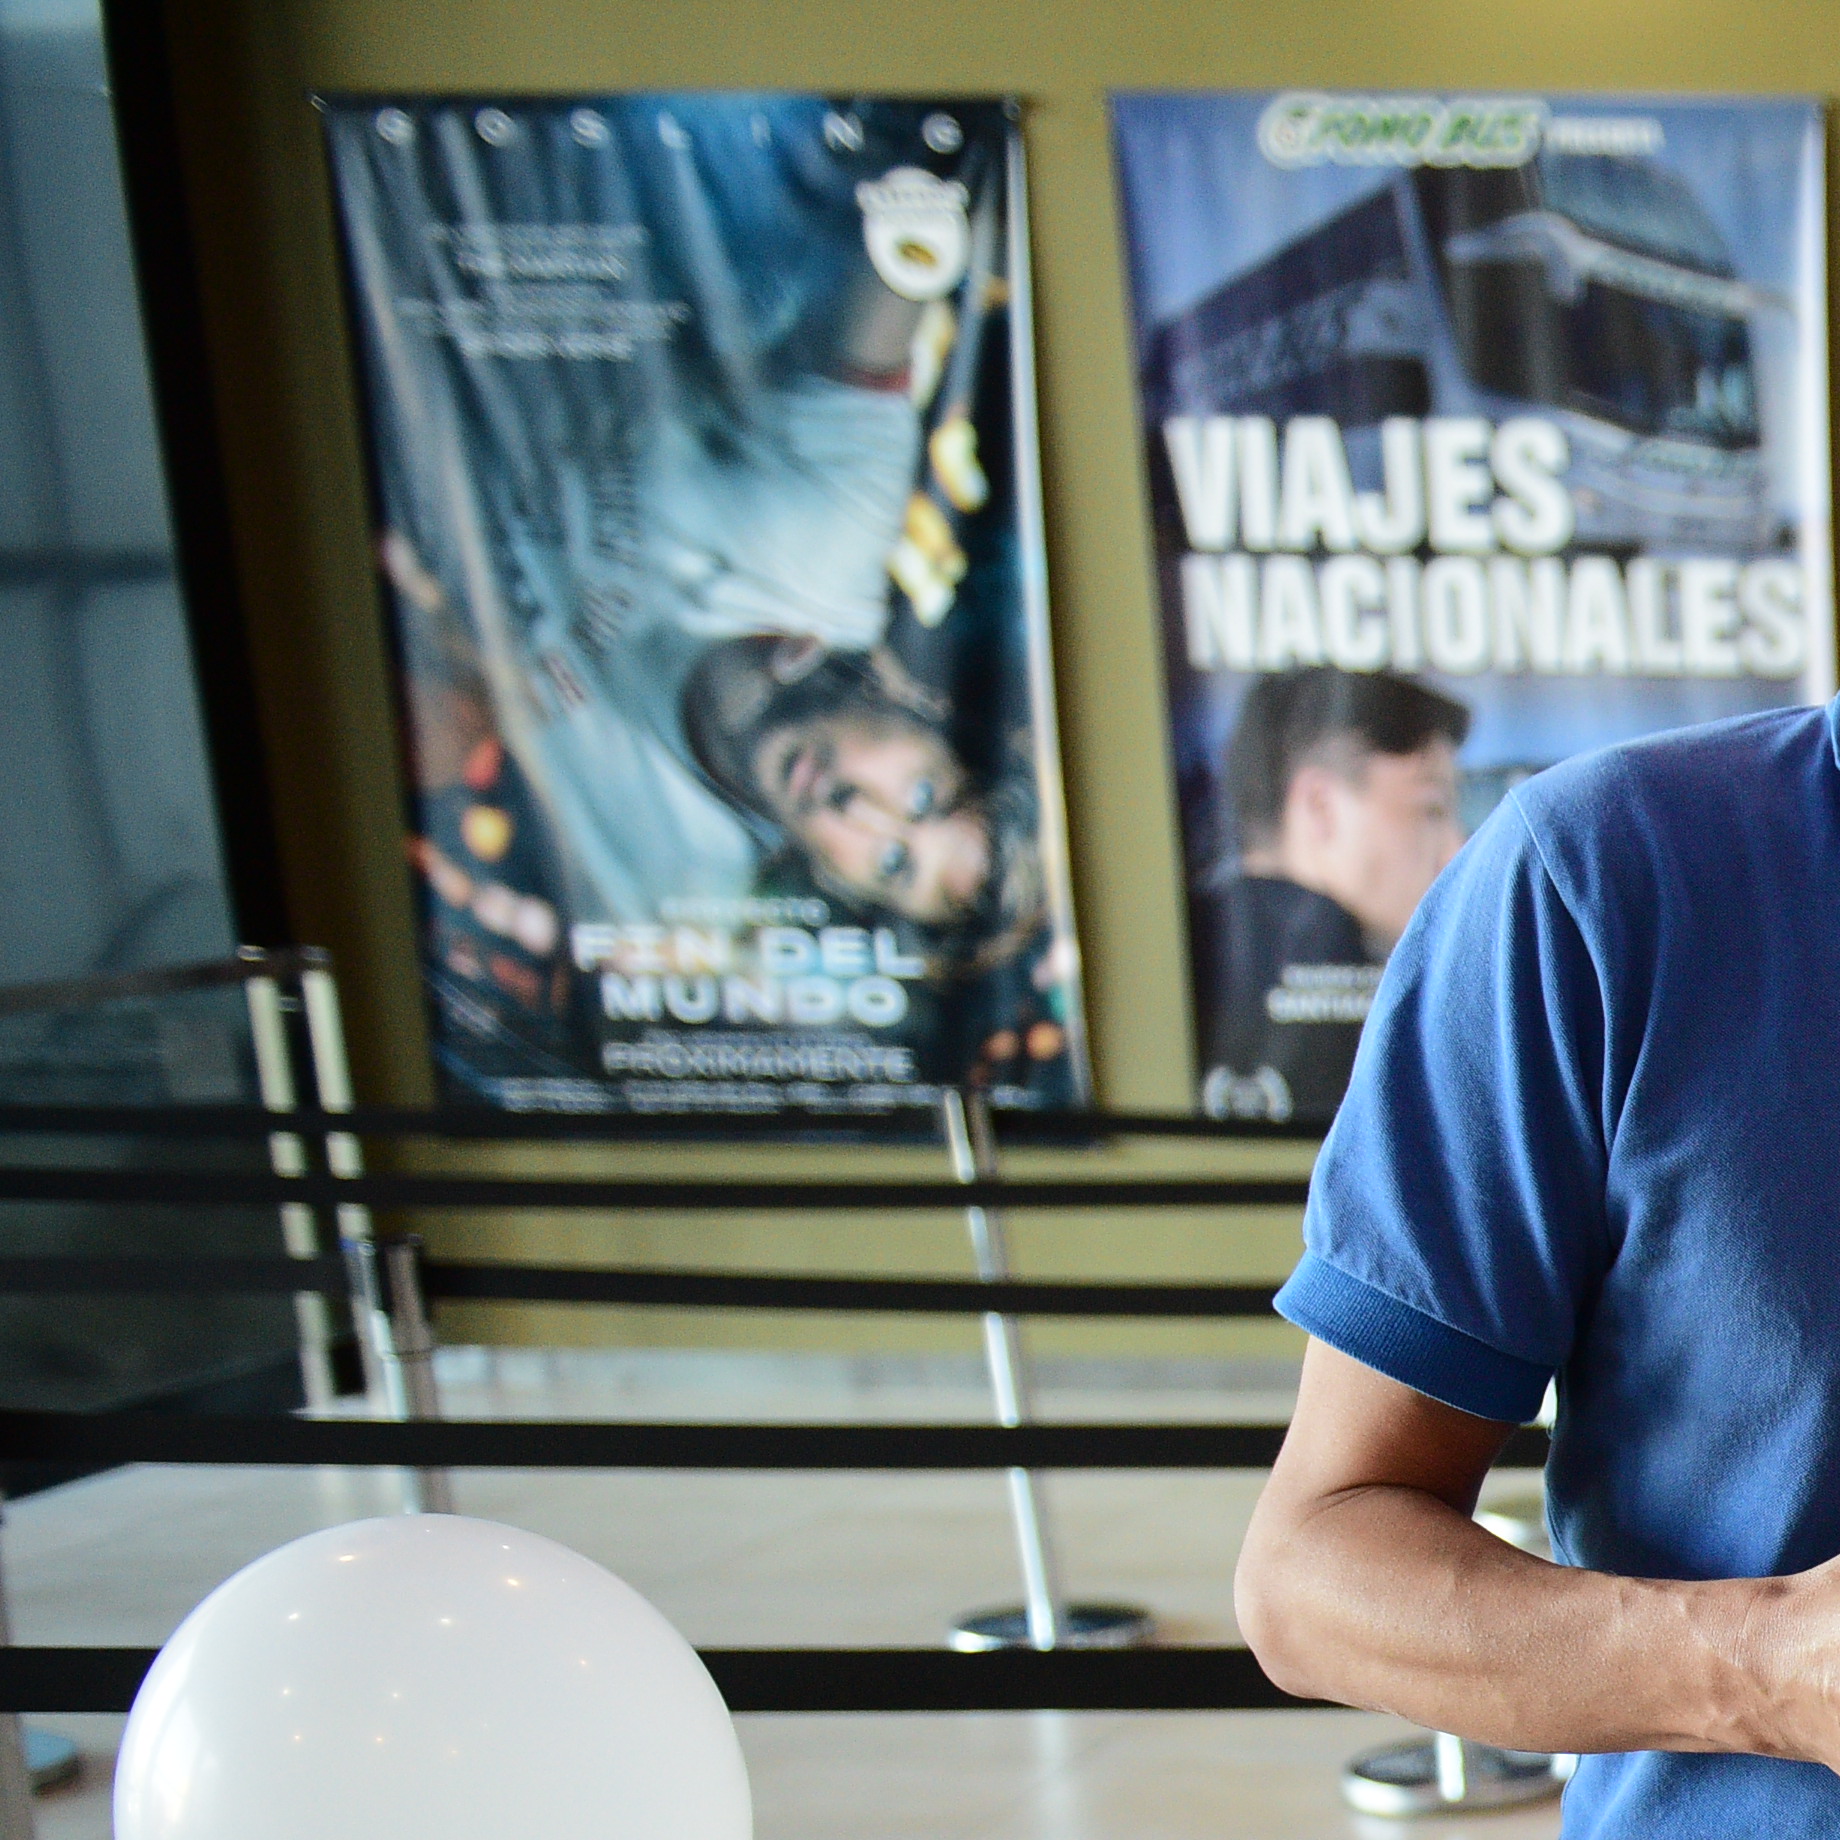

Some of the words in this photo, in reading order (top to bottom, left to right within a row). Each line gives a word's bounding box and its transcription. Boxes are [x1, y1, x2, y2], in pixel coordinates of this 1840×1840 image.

[1163, 415, 1573, 555] VIAJES
[1183, 552, 1808, 677] NACIONALES
[570, 921, 733, 975] FIN
[759, 925, 927, 980] DEL
[602, 973, 910, 1028] MUNDO
